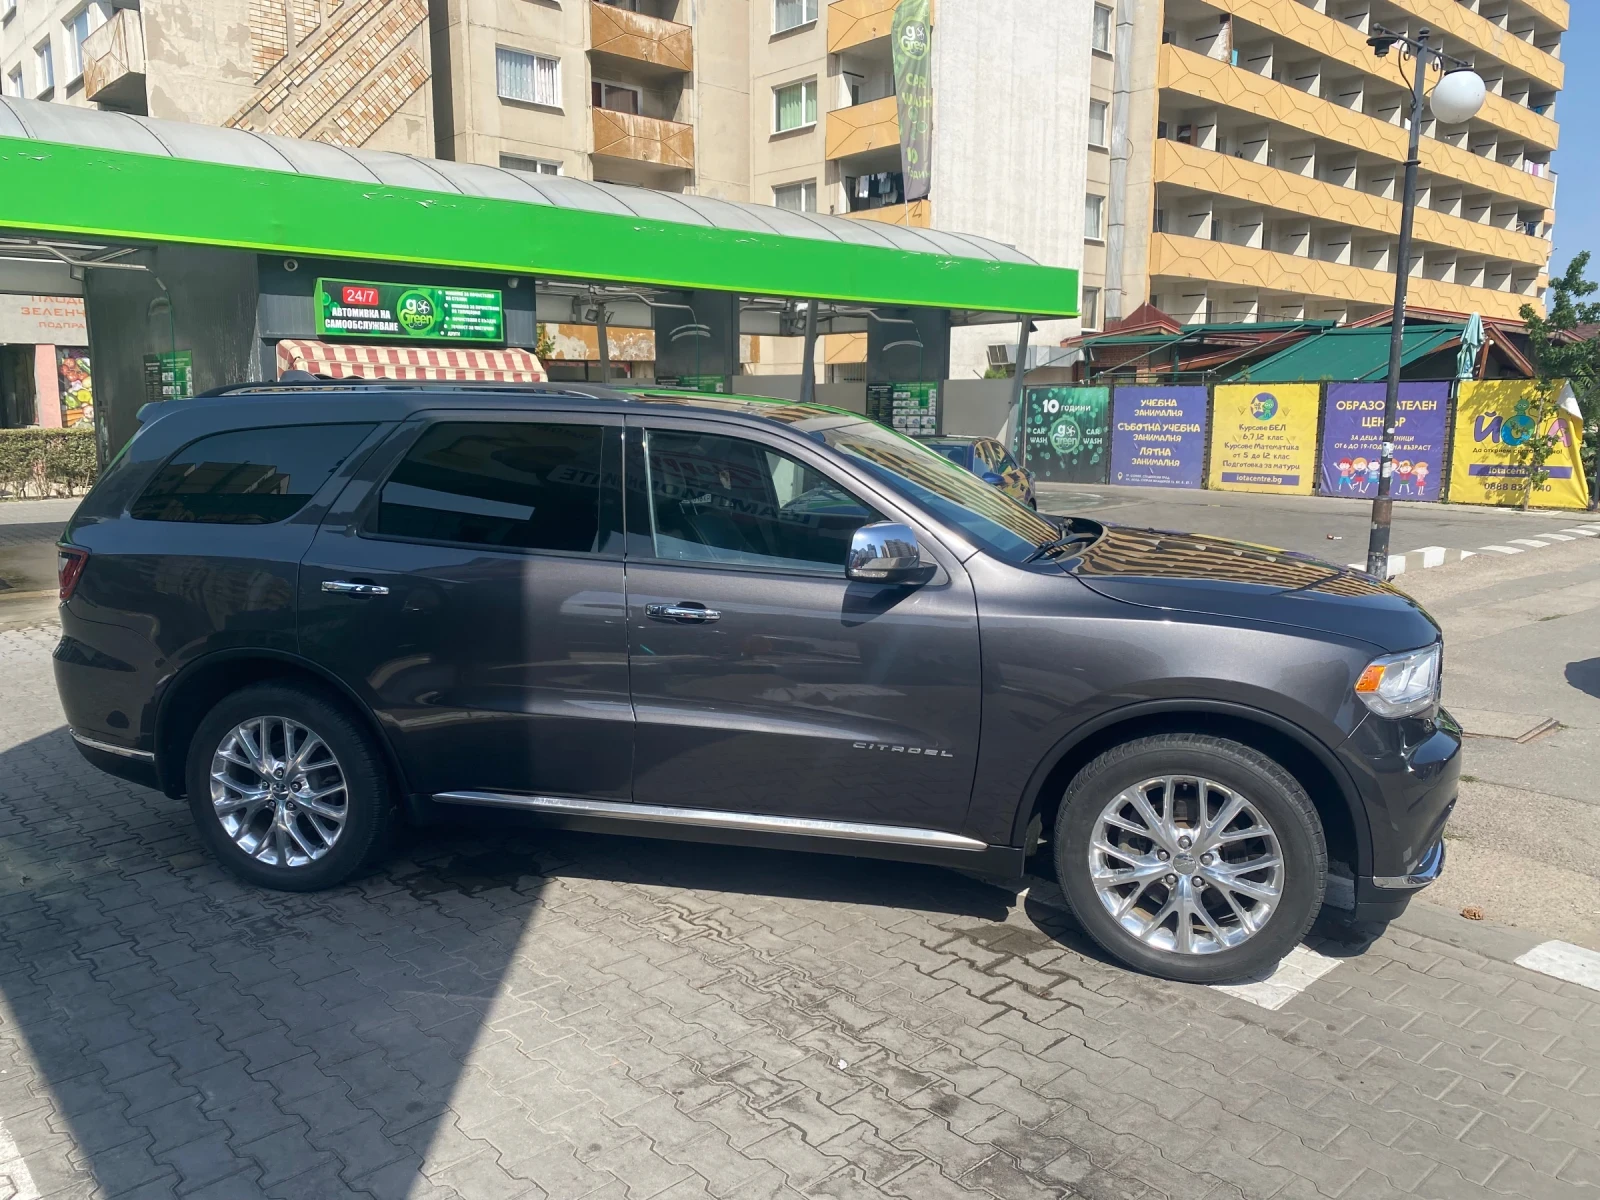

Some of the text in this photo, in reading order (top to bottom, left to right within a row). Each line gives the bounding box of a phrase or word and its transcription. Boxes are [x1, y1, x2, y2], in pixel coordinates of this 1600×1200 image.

[905, 72, 927, 89] CAR
[906, 146, 919, 164] 10
[346, 289, 375, 303] 24/7
[332, 307, 391, 320] АВТОМИВКА НА
[401, 309, 433, 324] Green
[325, 319, 398, 332] САМООБСЛУЖВАНЕ
[1042, 399, 1060, 413] 10
[1140, 398, 1177, 407] УЧЕБНА
[1336, 400, 1437, 411] ОБРАЗОАТЕЛЕН
[1134, 409, 1183, 417] ЗАНИМАЛНЯ
[1117, 422, 1201, 433] СЪБОТНА УЧЕБНА
[1361, 416, 1406, 428] ЦЕНР
[1238, 424, 1268, 432] Курсове
[1473, 411, 1572, 448] ЙОА
[1133, 434, 1182, 442] ЗАНИМАЛНЯ
[1139, 446, 1171, 456] ЛЯТНА
[1224, 442, 1299, 451] Курсове Математика
[1131, 457, 1180, 467] ЗАНИМАЛНЯ
[1222, 460, 1263, 468] Подготовка
[1273, 463, 1300, 471] матури
[1236, 474, 1283, 484] iotacentre.bg
[1484, 483, 1508, 491] 0888
[852, 741, 953, 757] CITADEL
